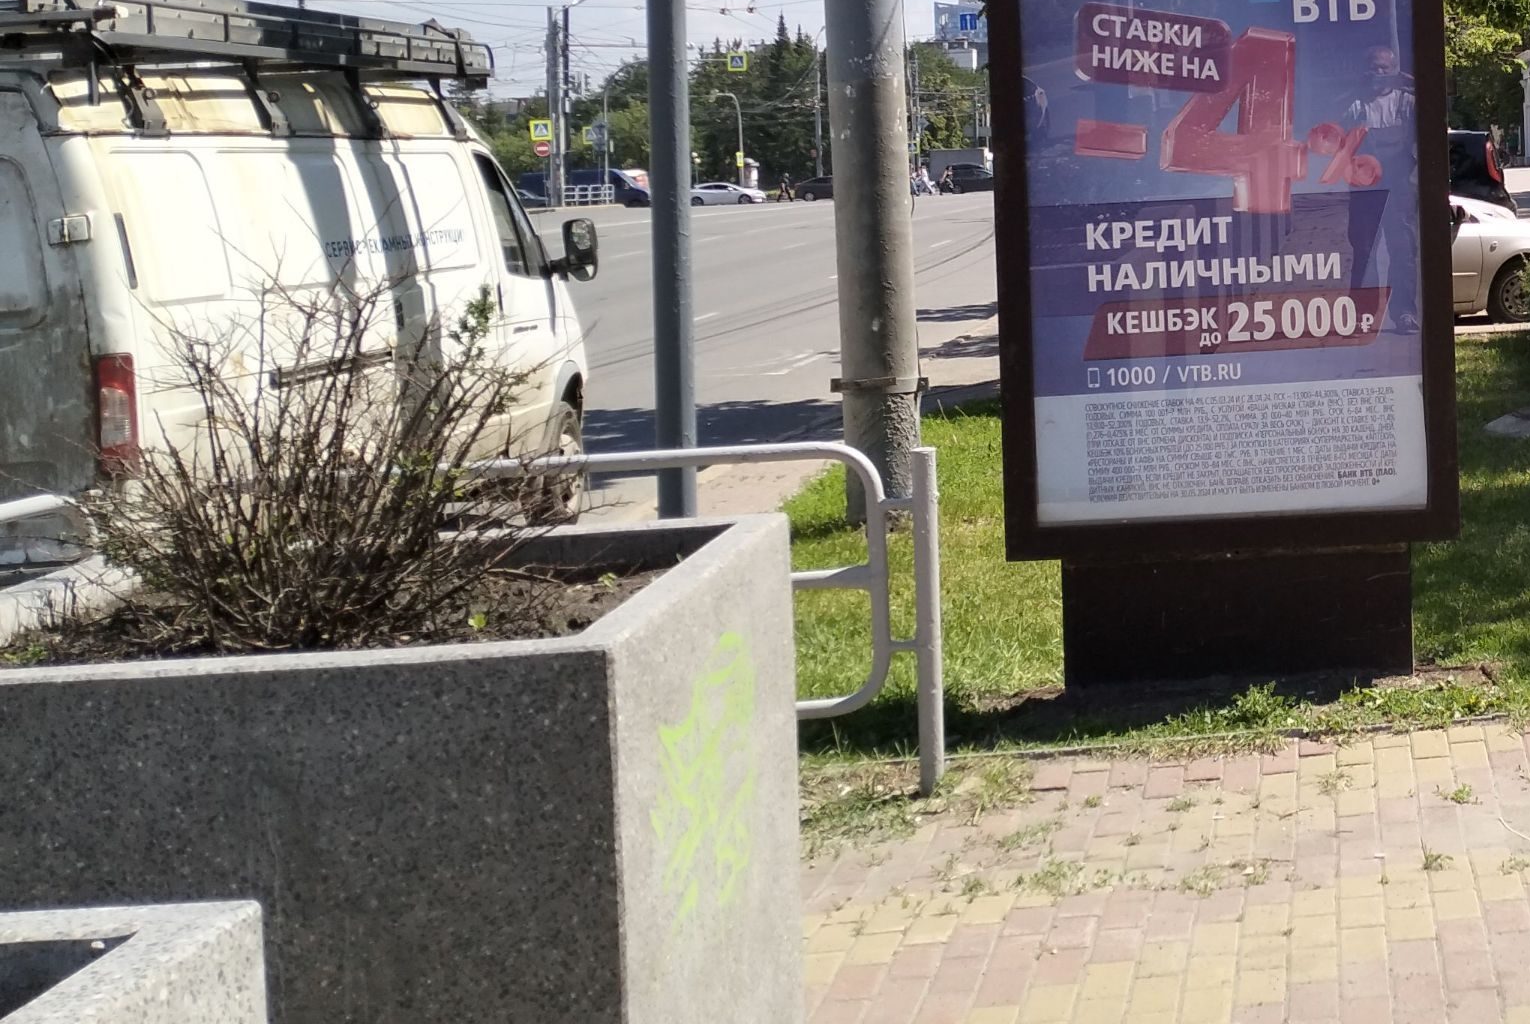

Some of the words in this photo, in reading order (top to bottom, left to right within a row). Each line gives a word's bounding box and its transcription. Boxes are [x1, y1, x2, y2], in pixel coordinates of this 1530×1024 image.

[1092, 13, 1202, 49] СТАВКИ
[1091, 45, 1175, 77] НИЖЕ
[1181, 54, 1220, 81] НА
[1086, 215, 1233, 253] КРЕДИТ
[1087, 252, 1342, 293] НАЛИЧНЫМИ
[1107, 307, 1219, 336] КЕШБЭК
[1106, 366, 1156, 386] 1000
[1176, 363, 1242, 383] VTB.RU
[1338, 470, 1357, 479] БАНК
